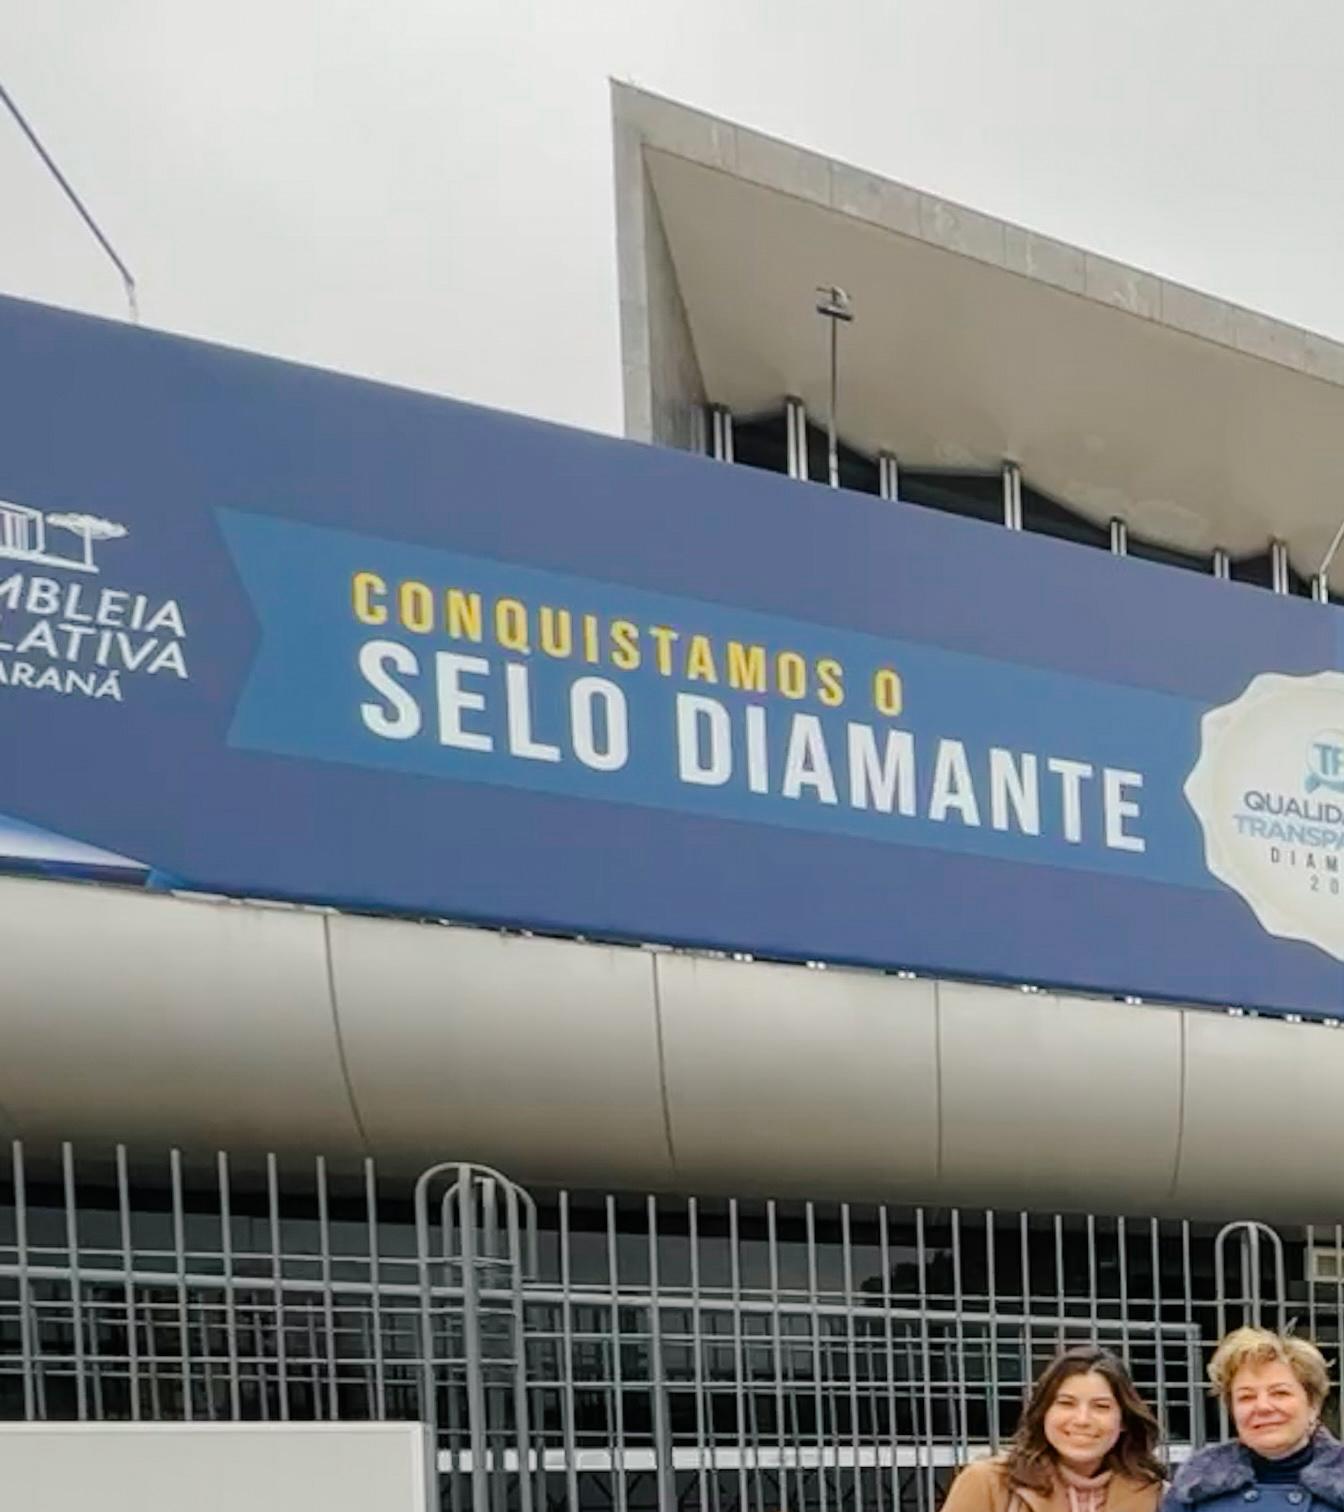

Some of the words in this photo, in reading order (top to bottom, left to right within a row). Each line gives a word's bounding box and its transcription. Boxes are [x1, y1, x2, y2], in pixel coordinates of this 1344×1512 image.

[0, 615, 189, 679] ATIVA
[352, 571, 845, 707] CONQUISTAMOS
[873, 668, 903, 717] O
[358, 639, 630, 772] SELO
[675, 691, 1146, 853] DIAMANTE
